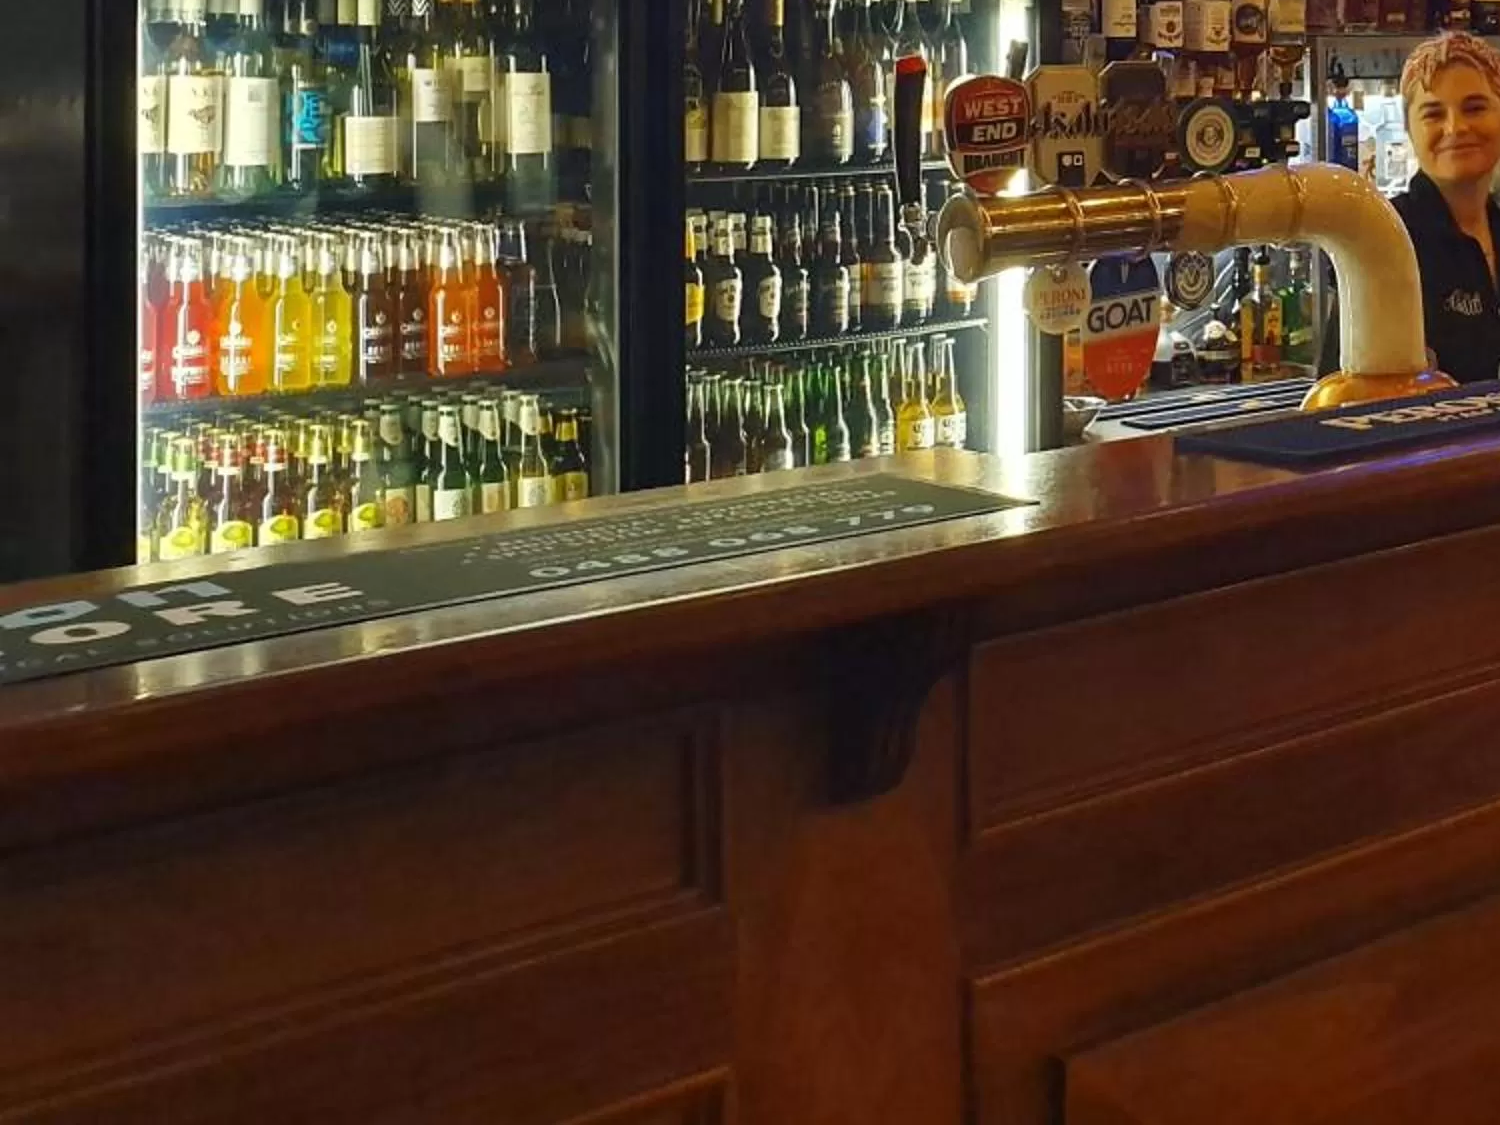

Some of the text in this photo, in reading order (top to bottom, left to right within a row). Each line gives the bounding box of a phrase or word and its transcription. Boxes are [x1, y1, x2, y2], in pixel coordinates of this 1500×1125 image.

[963, 97, 1024, 119] WEST
[971, 121, 1018, 144] END
[1086, 295, 1157, 334] GOAT
[0, 582, 365, 657] ORE
